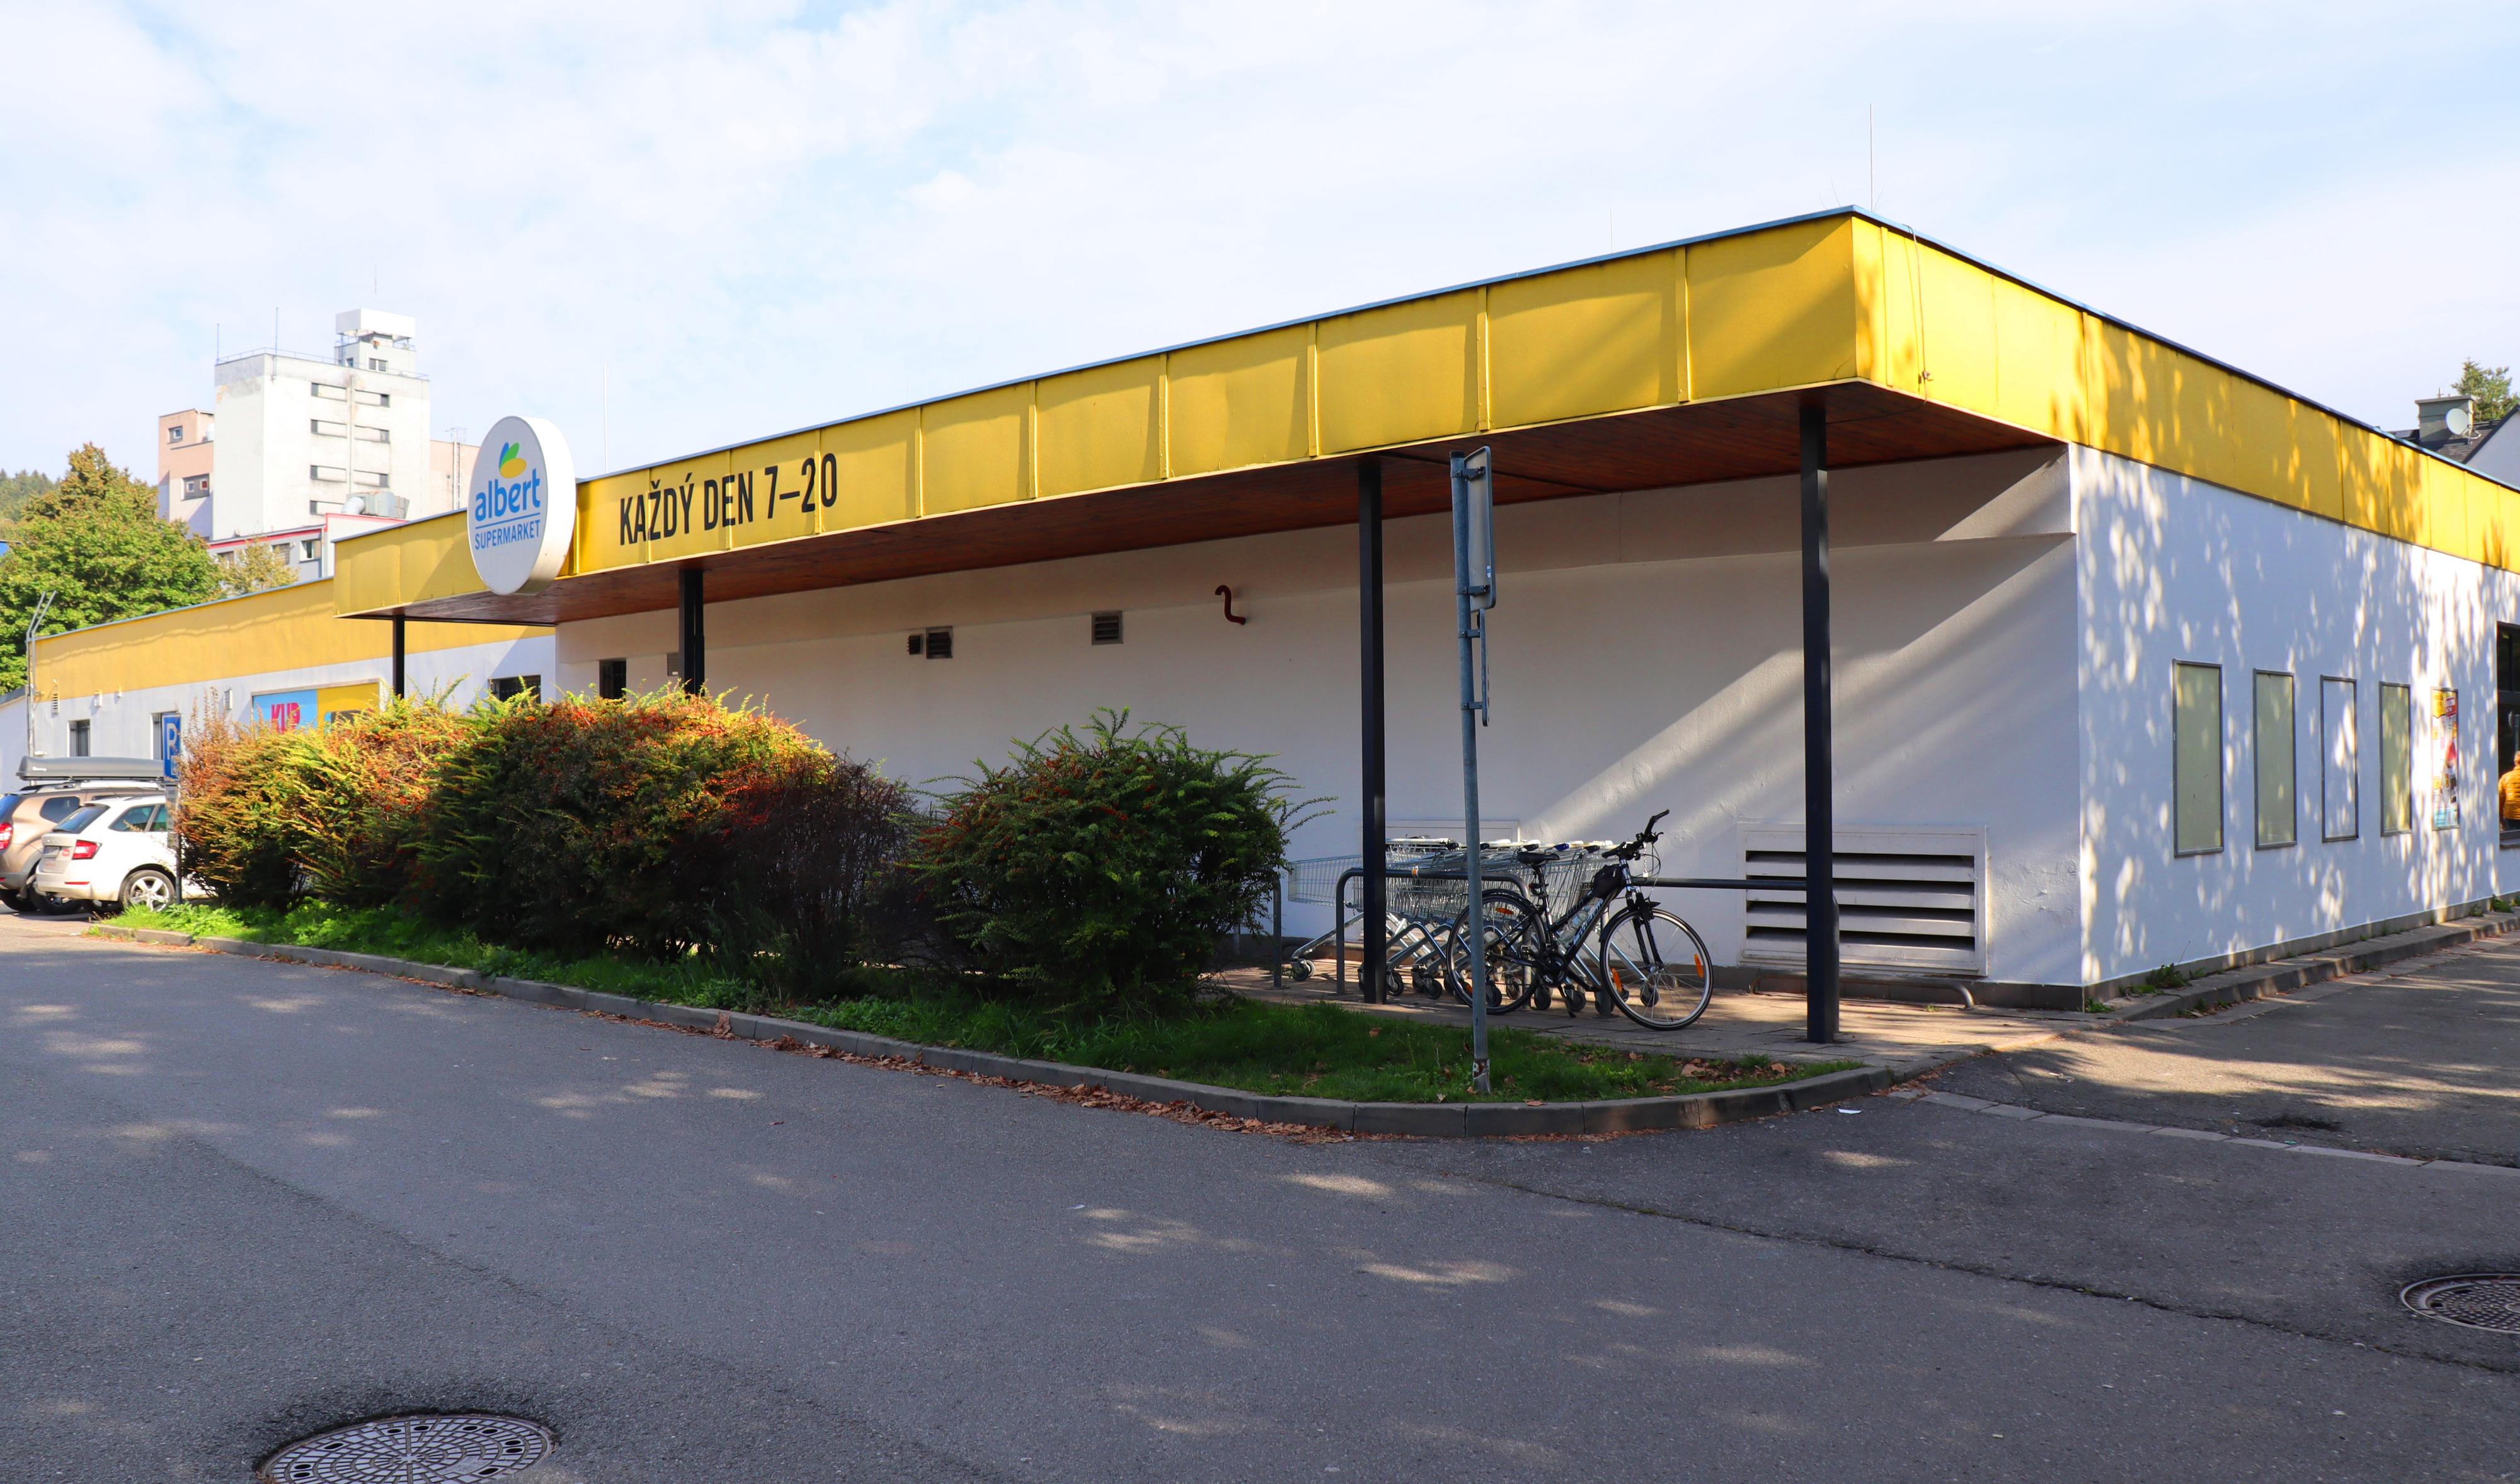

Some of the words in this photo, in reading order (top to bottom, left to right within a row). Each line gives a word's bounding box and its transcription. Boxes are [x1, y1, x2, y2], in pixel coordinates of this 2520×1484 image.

[474, 468, 541, 522] albert
[620, 472, 694, 546] KAŽDÝ
[704, 470, 753, 531] DEN
[474, 519, 541, 550] SUPERMARKET
[272, 702, 301, 732] KUP
[166, 722, 178, 761] P
